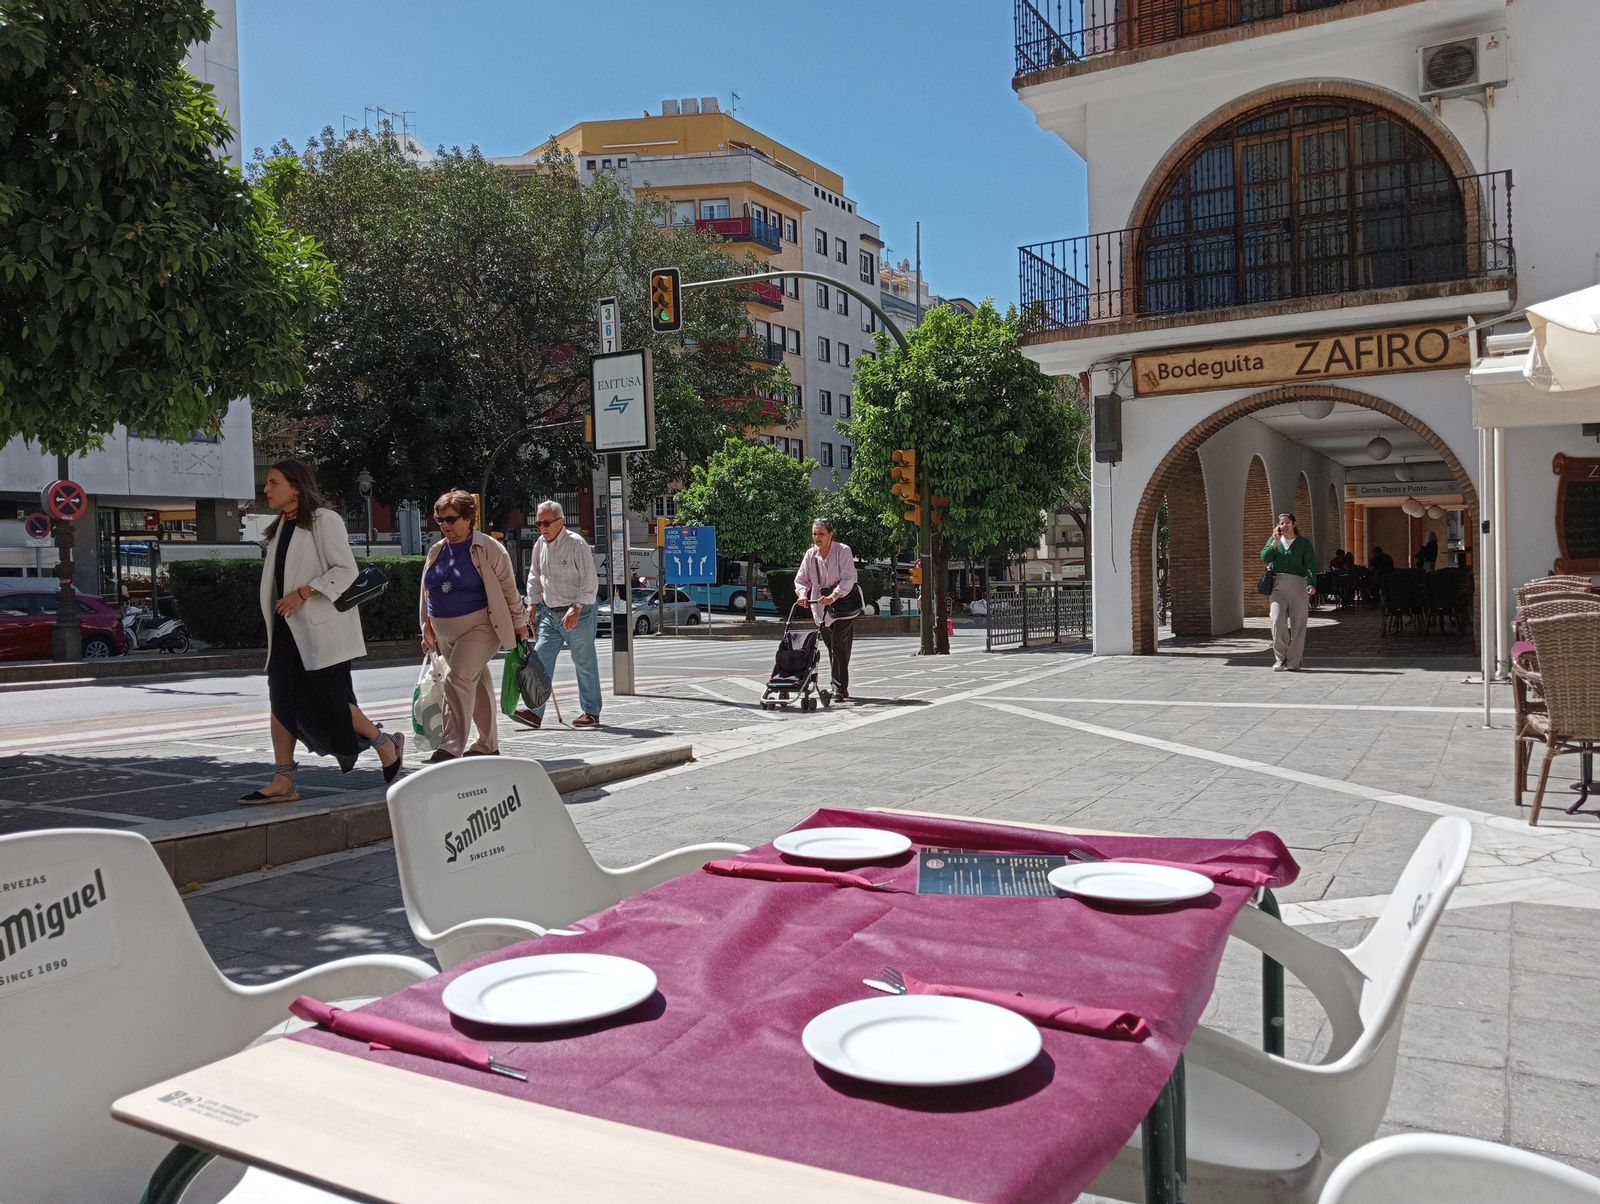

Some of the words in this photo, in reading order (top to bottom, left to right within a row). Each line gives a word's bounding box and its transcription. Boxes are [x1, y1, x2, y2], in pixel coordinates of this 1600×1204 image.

[604, 307, 611, 321] 3
[605, 324, 612, 337] 6
[606, 340, 612, 352] 7
[1157, 354, 1264, 381] Bodeguita
[1295, 328, 1450, 376] ZAFIRO
[597, 376, 642, 391] EMTUSA
[1382, 486, 1401, 494] Tapas
[457, 787, 488, 800] CERVEZAS
[469, 850, 488, 861] SINCE
[489, 845, 505, 856] 1890
[0, 968, 34, 986] SINCE
[38, 958, 68, 974] 1890
